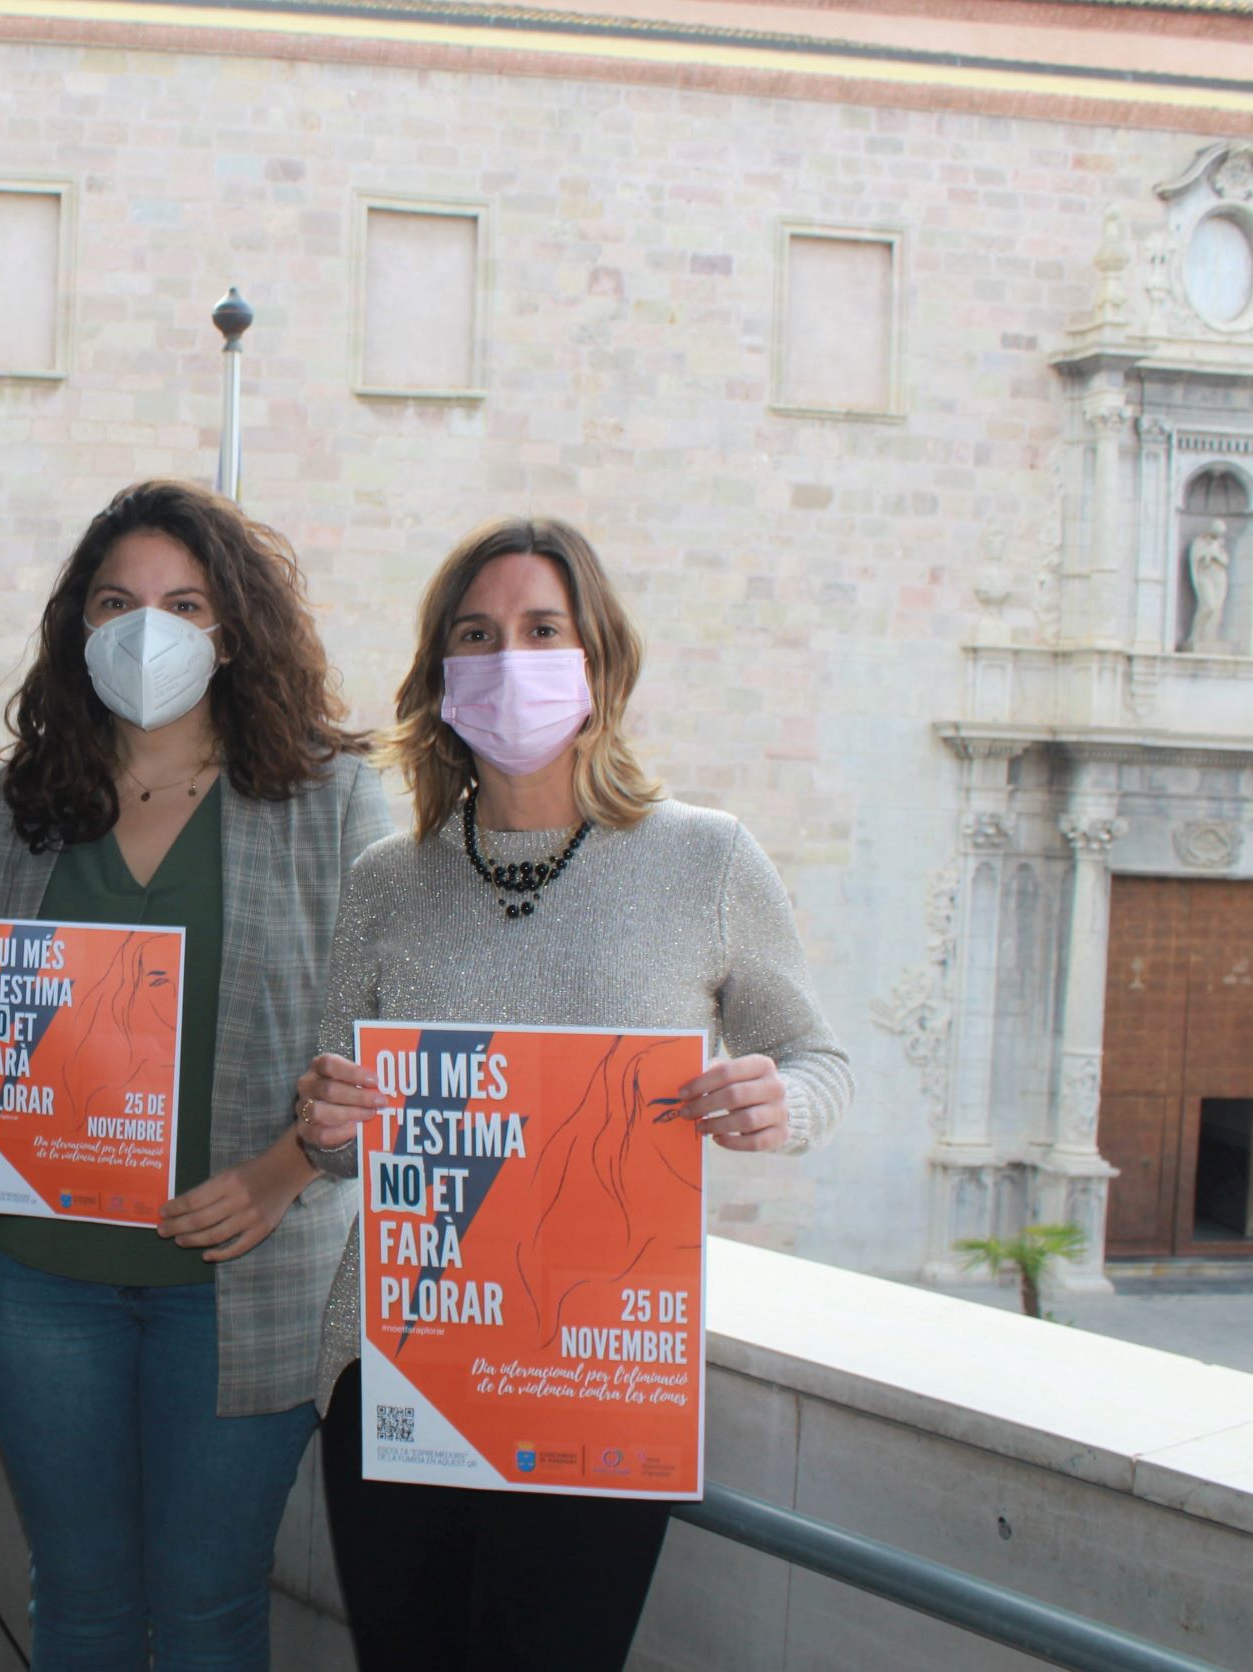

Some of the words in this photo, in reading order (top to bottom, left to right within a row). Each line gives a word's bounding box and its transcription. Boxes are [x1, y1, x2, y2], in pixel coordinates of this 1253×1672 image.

[23, 935, 64, 969] MÉS
[14, 1012, 37, 1042] ET
[376, 1049, 429, 1098] QUI
[441, 1045, 508, 1100] MÉS
[124, 1092, 143, 1115] 25
[147, 1094, 165, 1116] DE
[87, 1116, 164, 1142] NOVEMBRE
[376, 1107, 526, 1159] T'ESTIMA
[381, 1163, 420, 1207] NO
[433, 1168, 469, 1213] ET
[380, 1217, 463, 1269] FARÀ
[381, 1278, 504, 1326] PLORAR
[621, 1288, 651, 1322] 25
[659, 1291, 688, 1324] DE
[561, 1327, 688, 1365] NOVEMBRE
[472, 1358, 496, 1376] Dia
[500, 1360, 584, 1383] internacional
[585, 1368, 610, 1386] per
[477, 1378, 494, 1393] de
[498, 1377, 514, 1395] la
[579, 1382, 622, 1401] contra
[625, 1384, 645, 1404] les
[649, 1388, 688, 1406] dones
